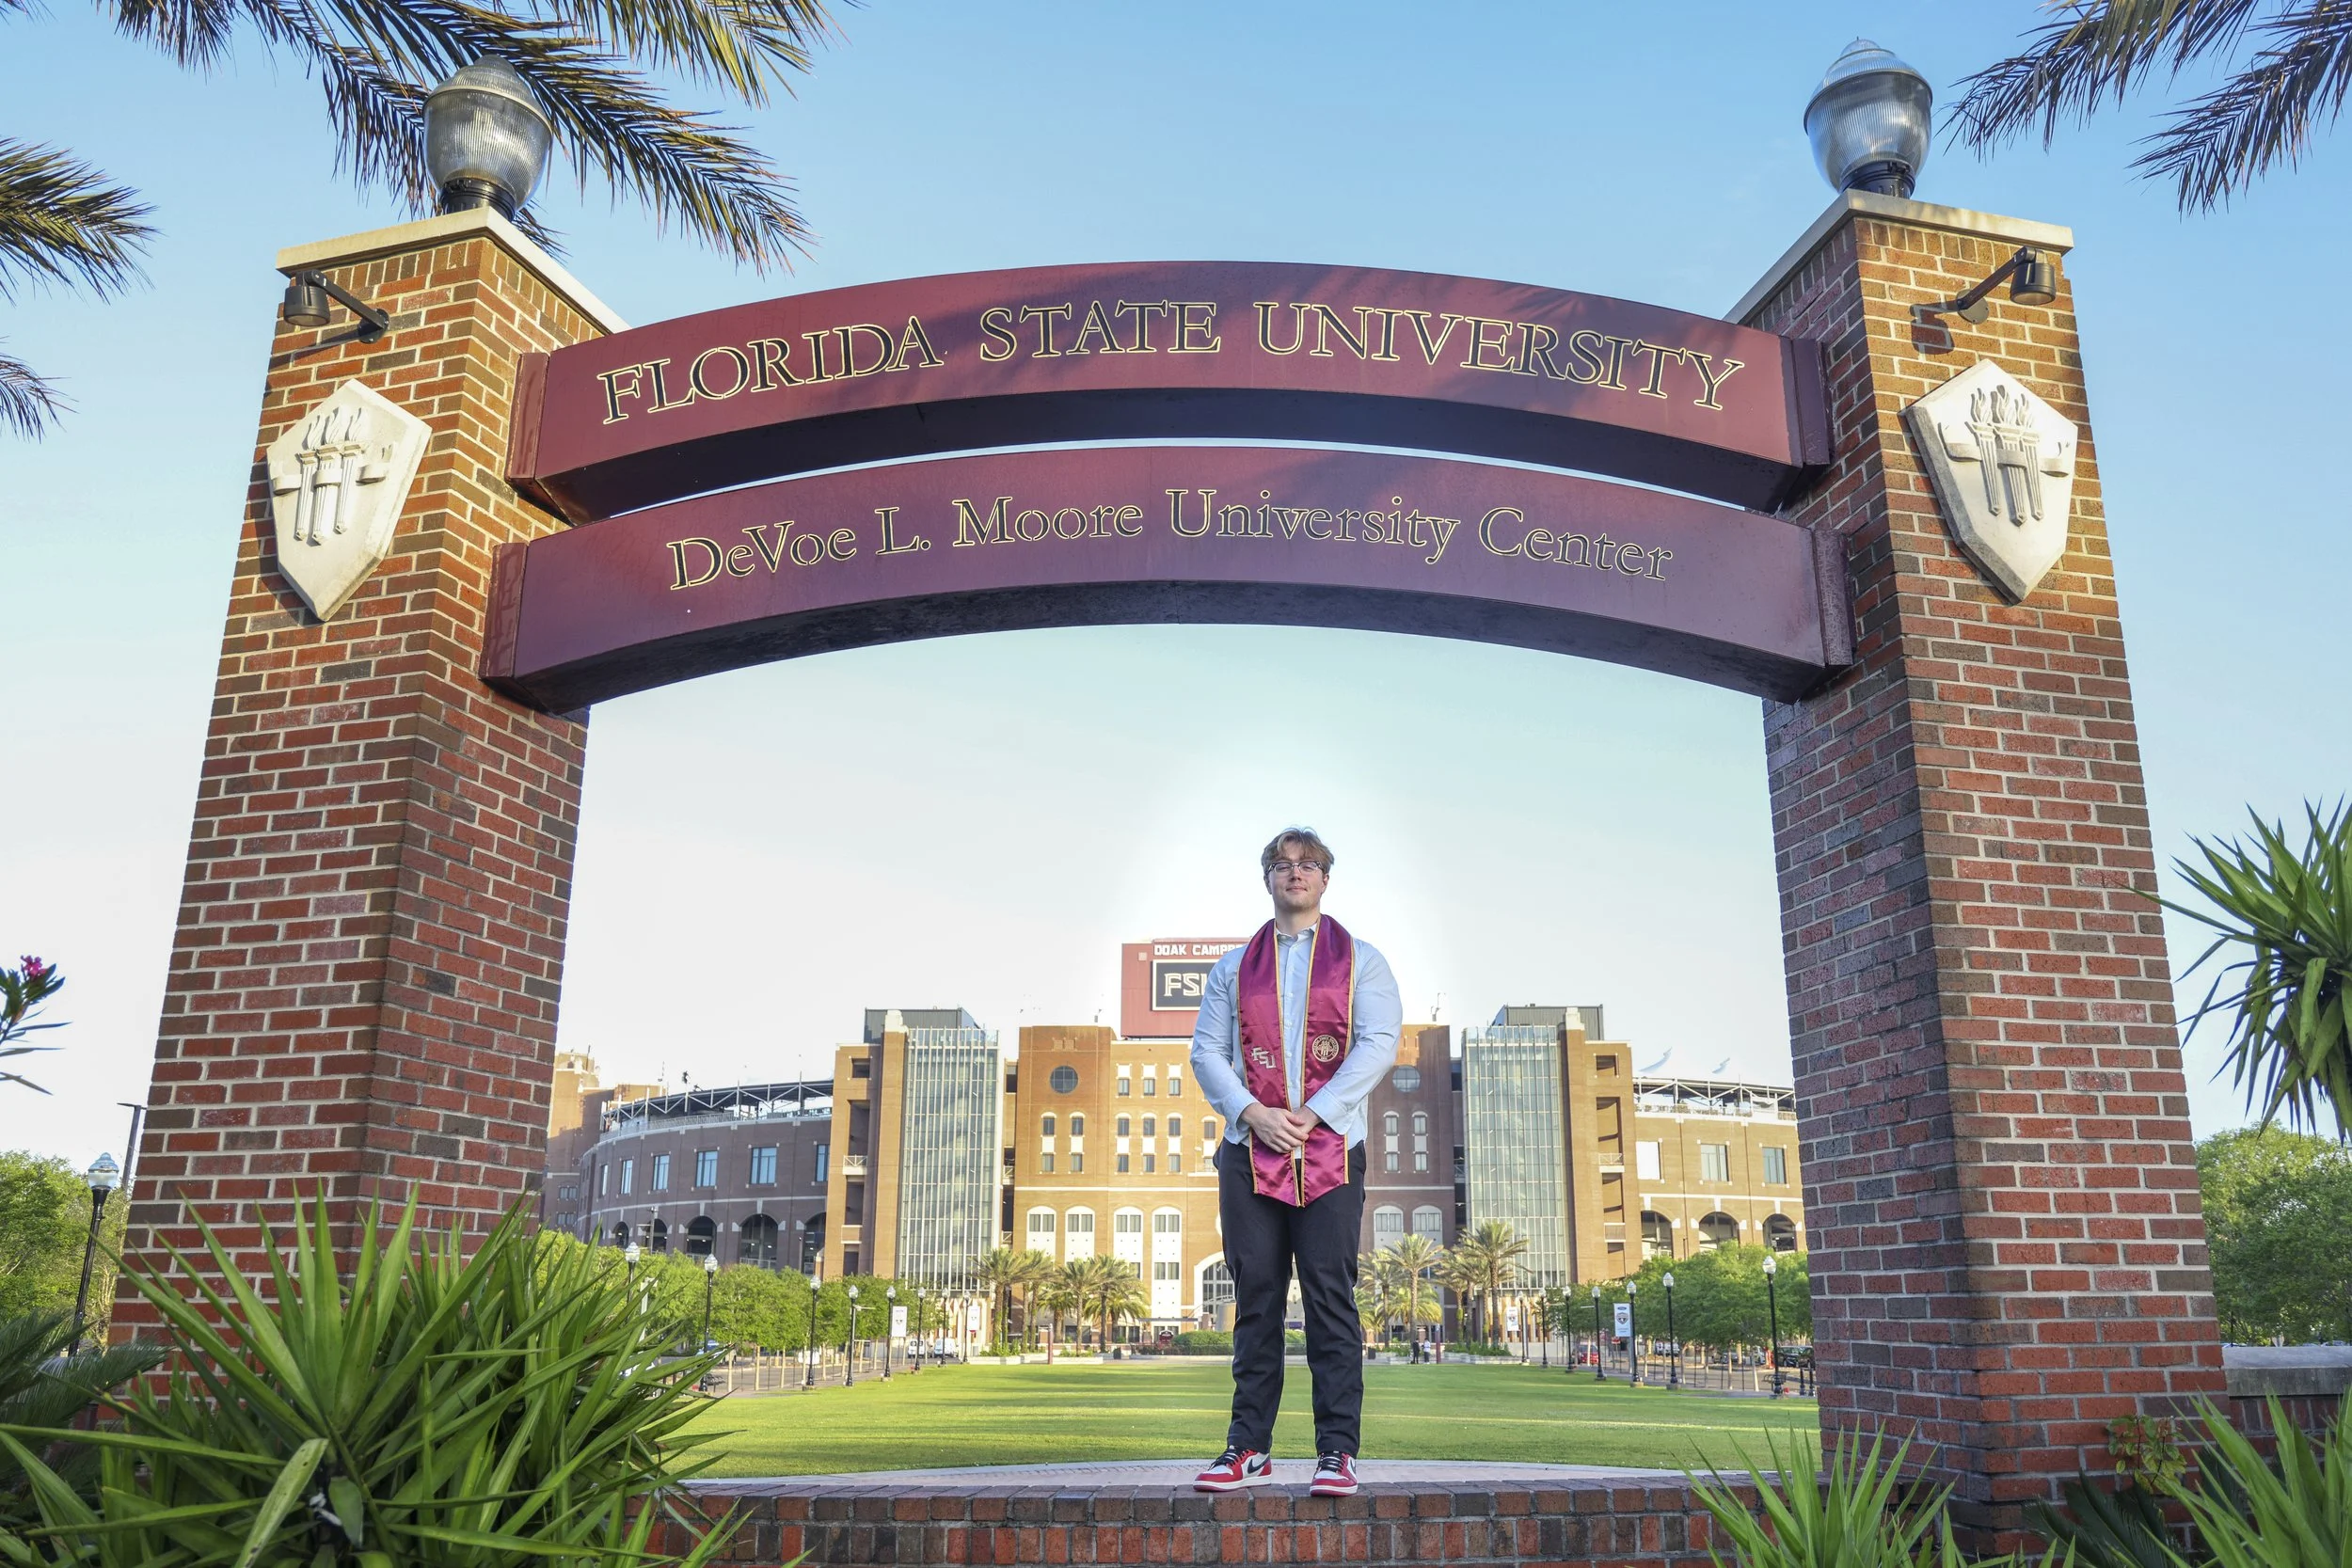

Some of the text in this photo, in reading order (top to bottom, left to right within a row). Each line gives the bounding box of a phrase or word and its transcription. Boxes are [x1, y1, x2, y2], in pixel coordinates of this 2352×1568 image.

[597, 300, 1743, 424] FLORIDA STATE UNIVERSITY
[666, 488, 1674, 591] DeVoe L. Moore University Center
[1153, 944, 1243, 956] DOAK CAMP
[1251, 1048, 1276, 1069] FSU
